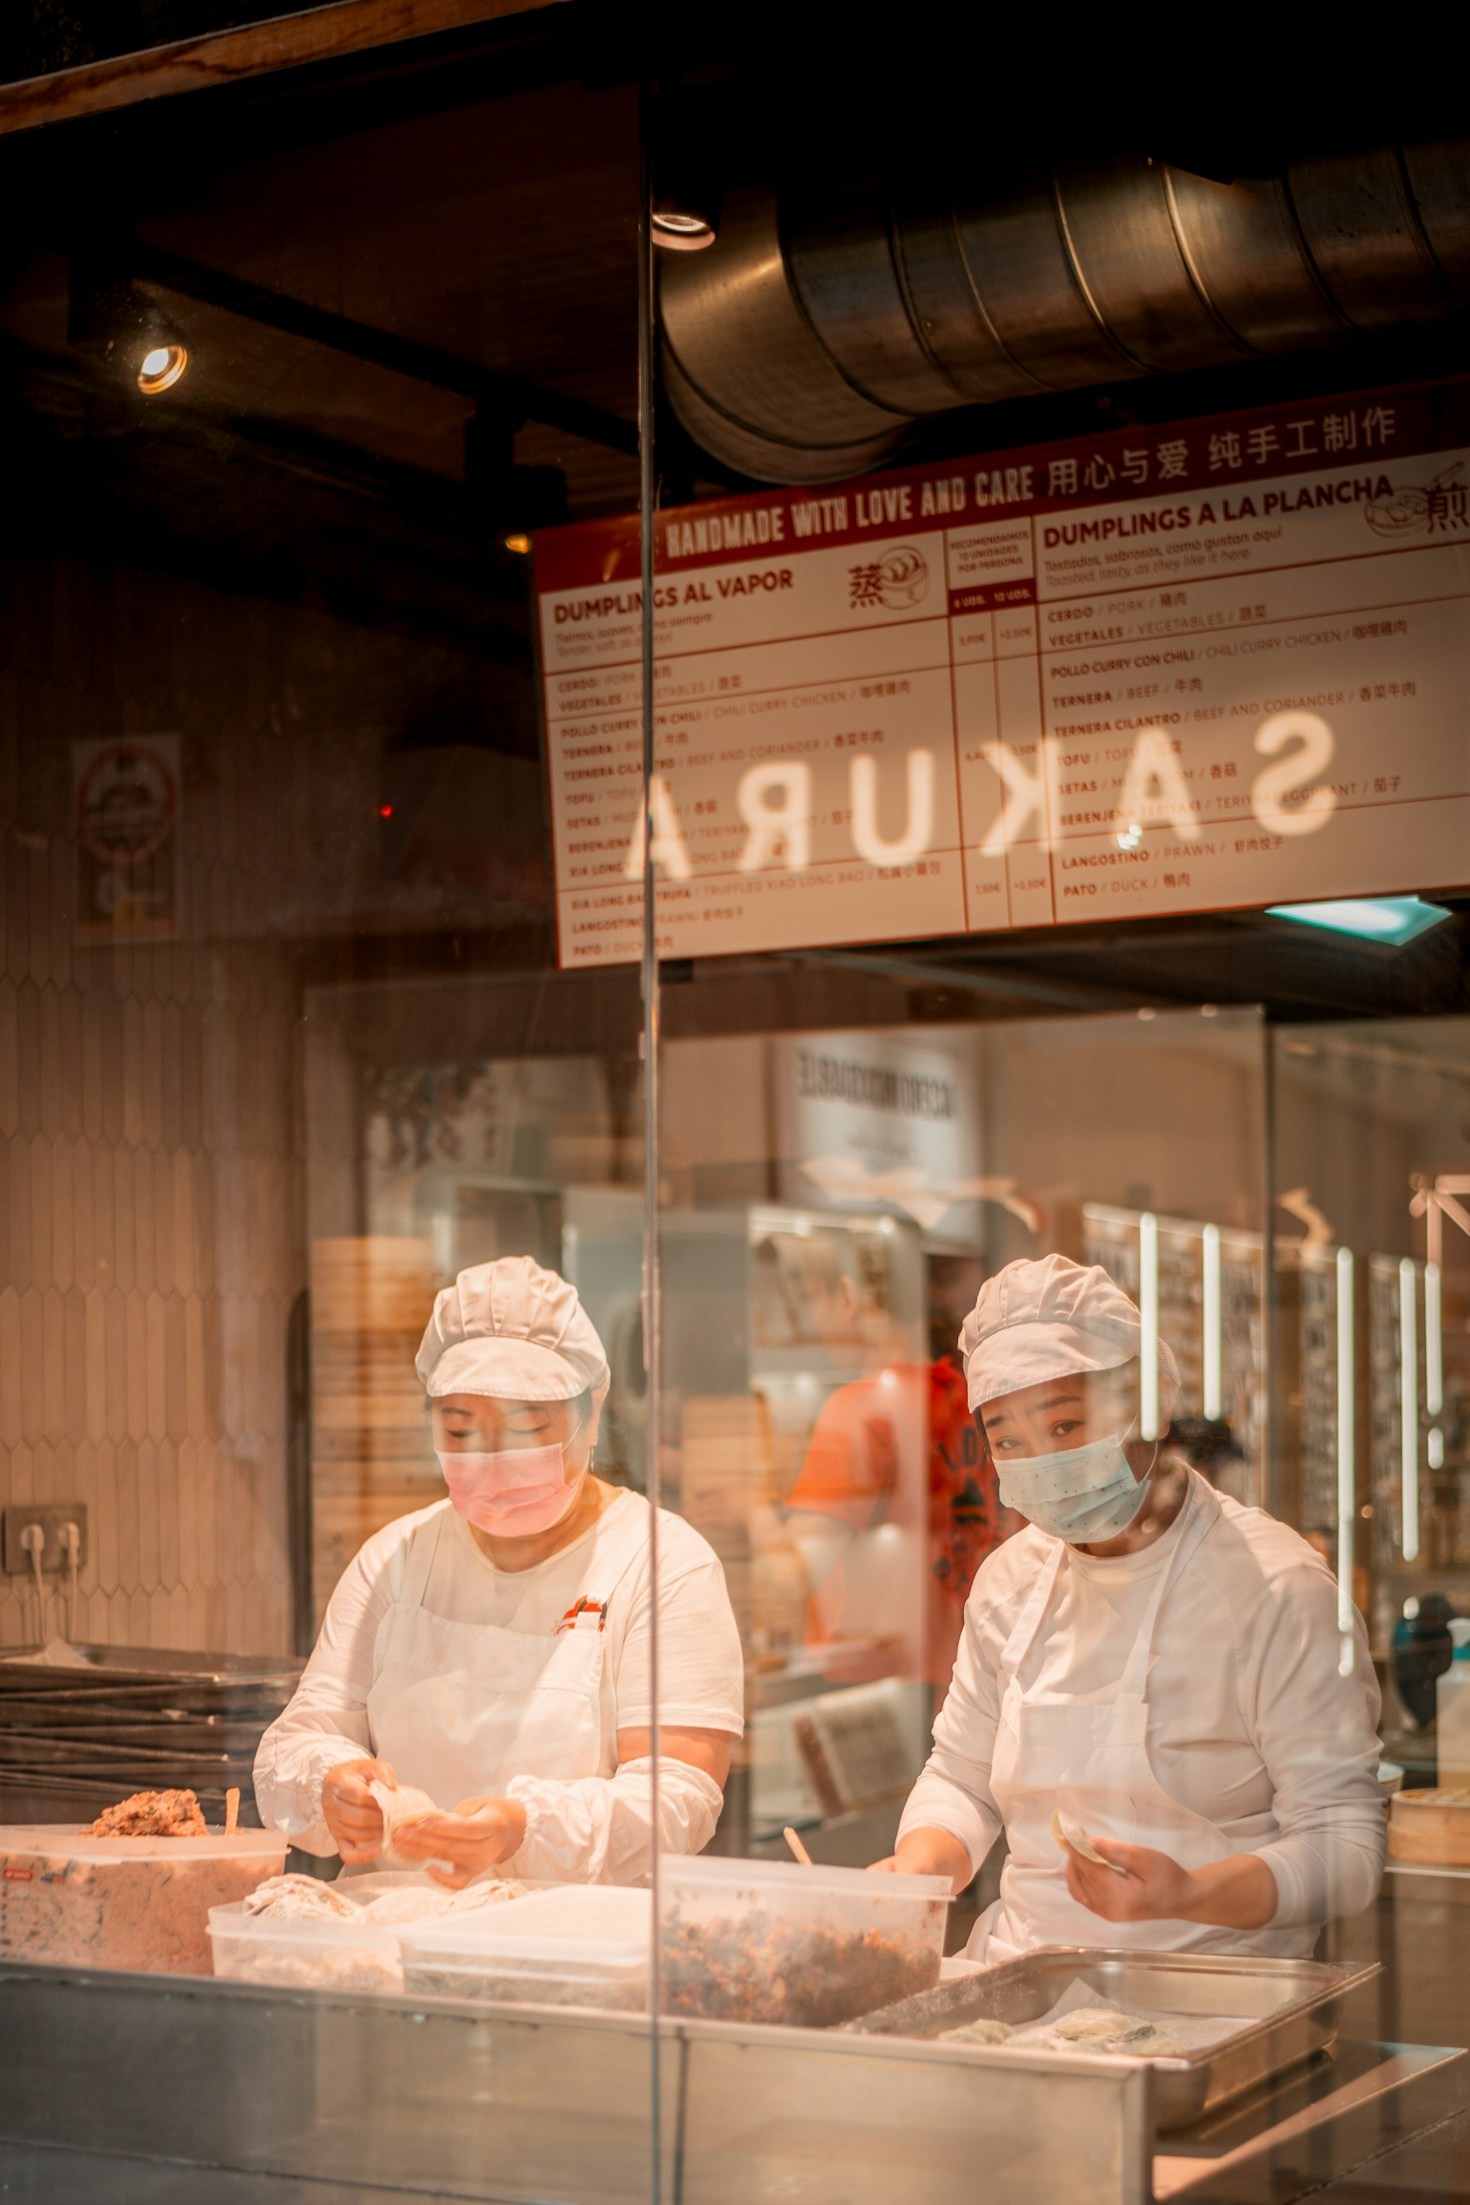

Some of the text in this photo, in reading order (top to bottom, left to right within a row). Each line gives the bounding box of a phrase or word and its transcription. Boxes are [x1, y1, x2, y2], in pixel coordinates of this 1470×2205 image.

[1048, 406, 1396, 497] 用心与爱 纯手工制作
[666, 464, 1034, 559] HANDMADE WITH LOVE AND CARE
[1043, 474, 1395, 549] DUMPLINGS A LA PLANCHA
[1426, 480, 1469, 535] 煎
[683, 582, 713, 605] AL
[716, 569, 793, 598] VAPOR
[848, 563, 884, 610] 蒸
[1048, 605, 1094, 623] CERDO
[1107, 596, 1145, 614] PORK
[1049, 626, 1124, 647] VEGETALES
[1137, 612, 1225, 635] VEGETABLES
[1051, 663, 1091, 679] POLLO
[1092, 657, 1133, 674] CURRY
[1134, 654, 1161, 669] CON
[1163, 649, 1195, 665] CHILI
[1240, 637, 1283, 654] CURRY
[1285, 629, 1341, 649] CHICKEN
[1052, 690, 1113, 709] TERNERA
[1126, 683, 1160, 700] BEEF
[1054, 720, 1112, 738] TERNERA
[1114, 711, 1182, 731] CILANTRO
[1193, 705, 1226, 722] BEEF
[1231, 702, 1259, 717] AND
[1263, 691, 1345, 713] CORIANDER
[617, 757, 676, 775] CILATRO
[1061, 849, 1150, 870] LANGOSTINO
[1163, 843, 1215, 860] PRAWN
[1063, 883, 1098, 898] PATO
[1111, 878, 1149, 893] DUCK
